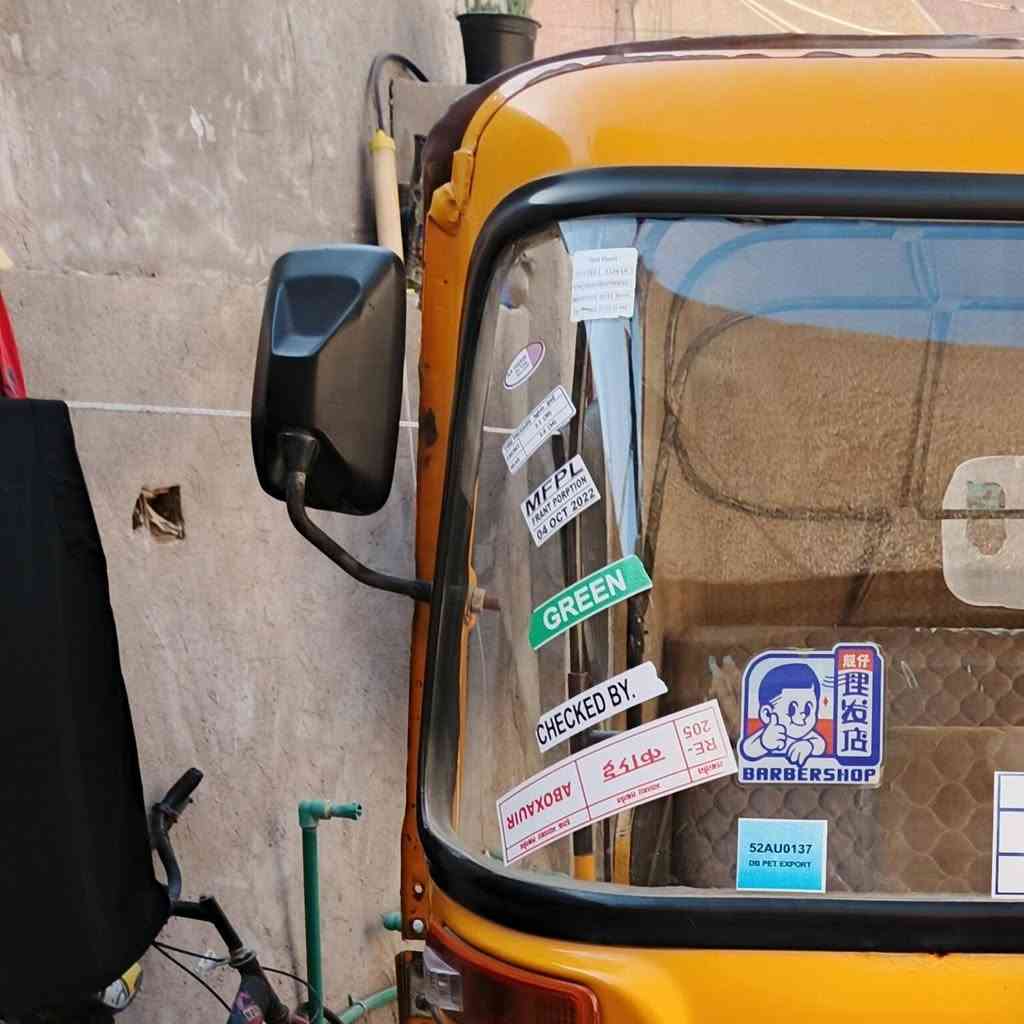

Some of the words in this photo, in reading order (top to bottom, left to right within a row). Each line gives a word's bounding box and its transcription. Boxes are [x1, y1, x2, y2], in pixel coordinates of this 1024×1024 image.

[525, 463, 583, 516] MFPL
[536, 525, 548, 540] 04
[549, 507, 568, 528] OCT
[570, 488, 595, 512] 2022
[543, 569, 628, 630] GREEN
[536, 698, 606, 745] CHECKED
[683, 719, 711, 738] 205
[743, 767, 876, 782] BARBERSHOP
[507, 782, 571, 830] ABOXAUIR
[749, 842, 813, 854] 52AU0137
